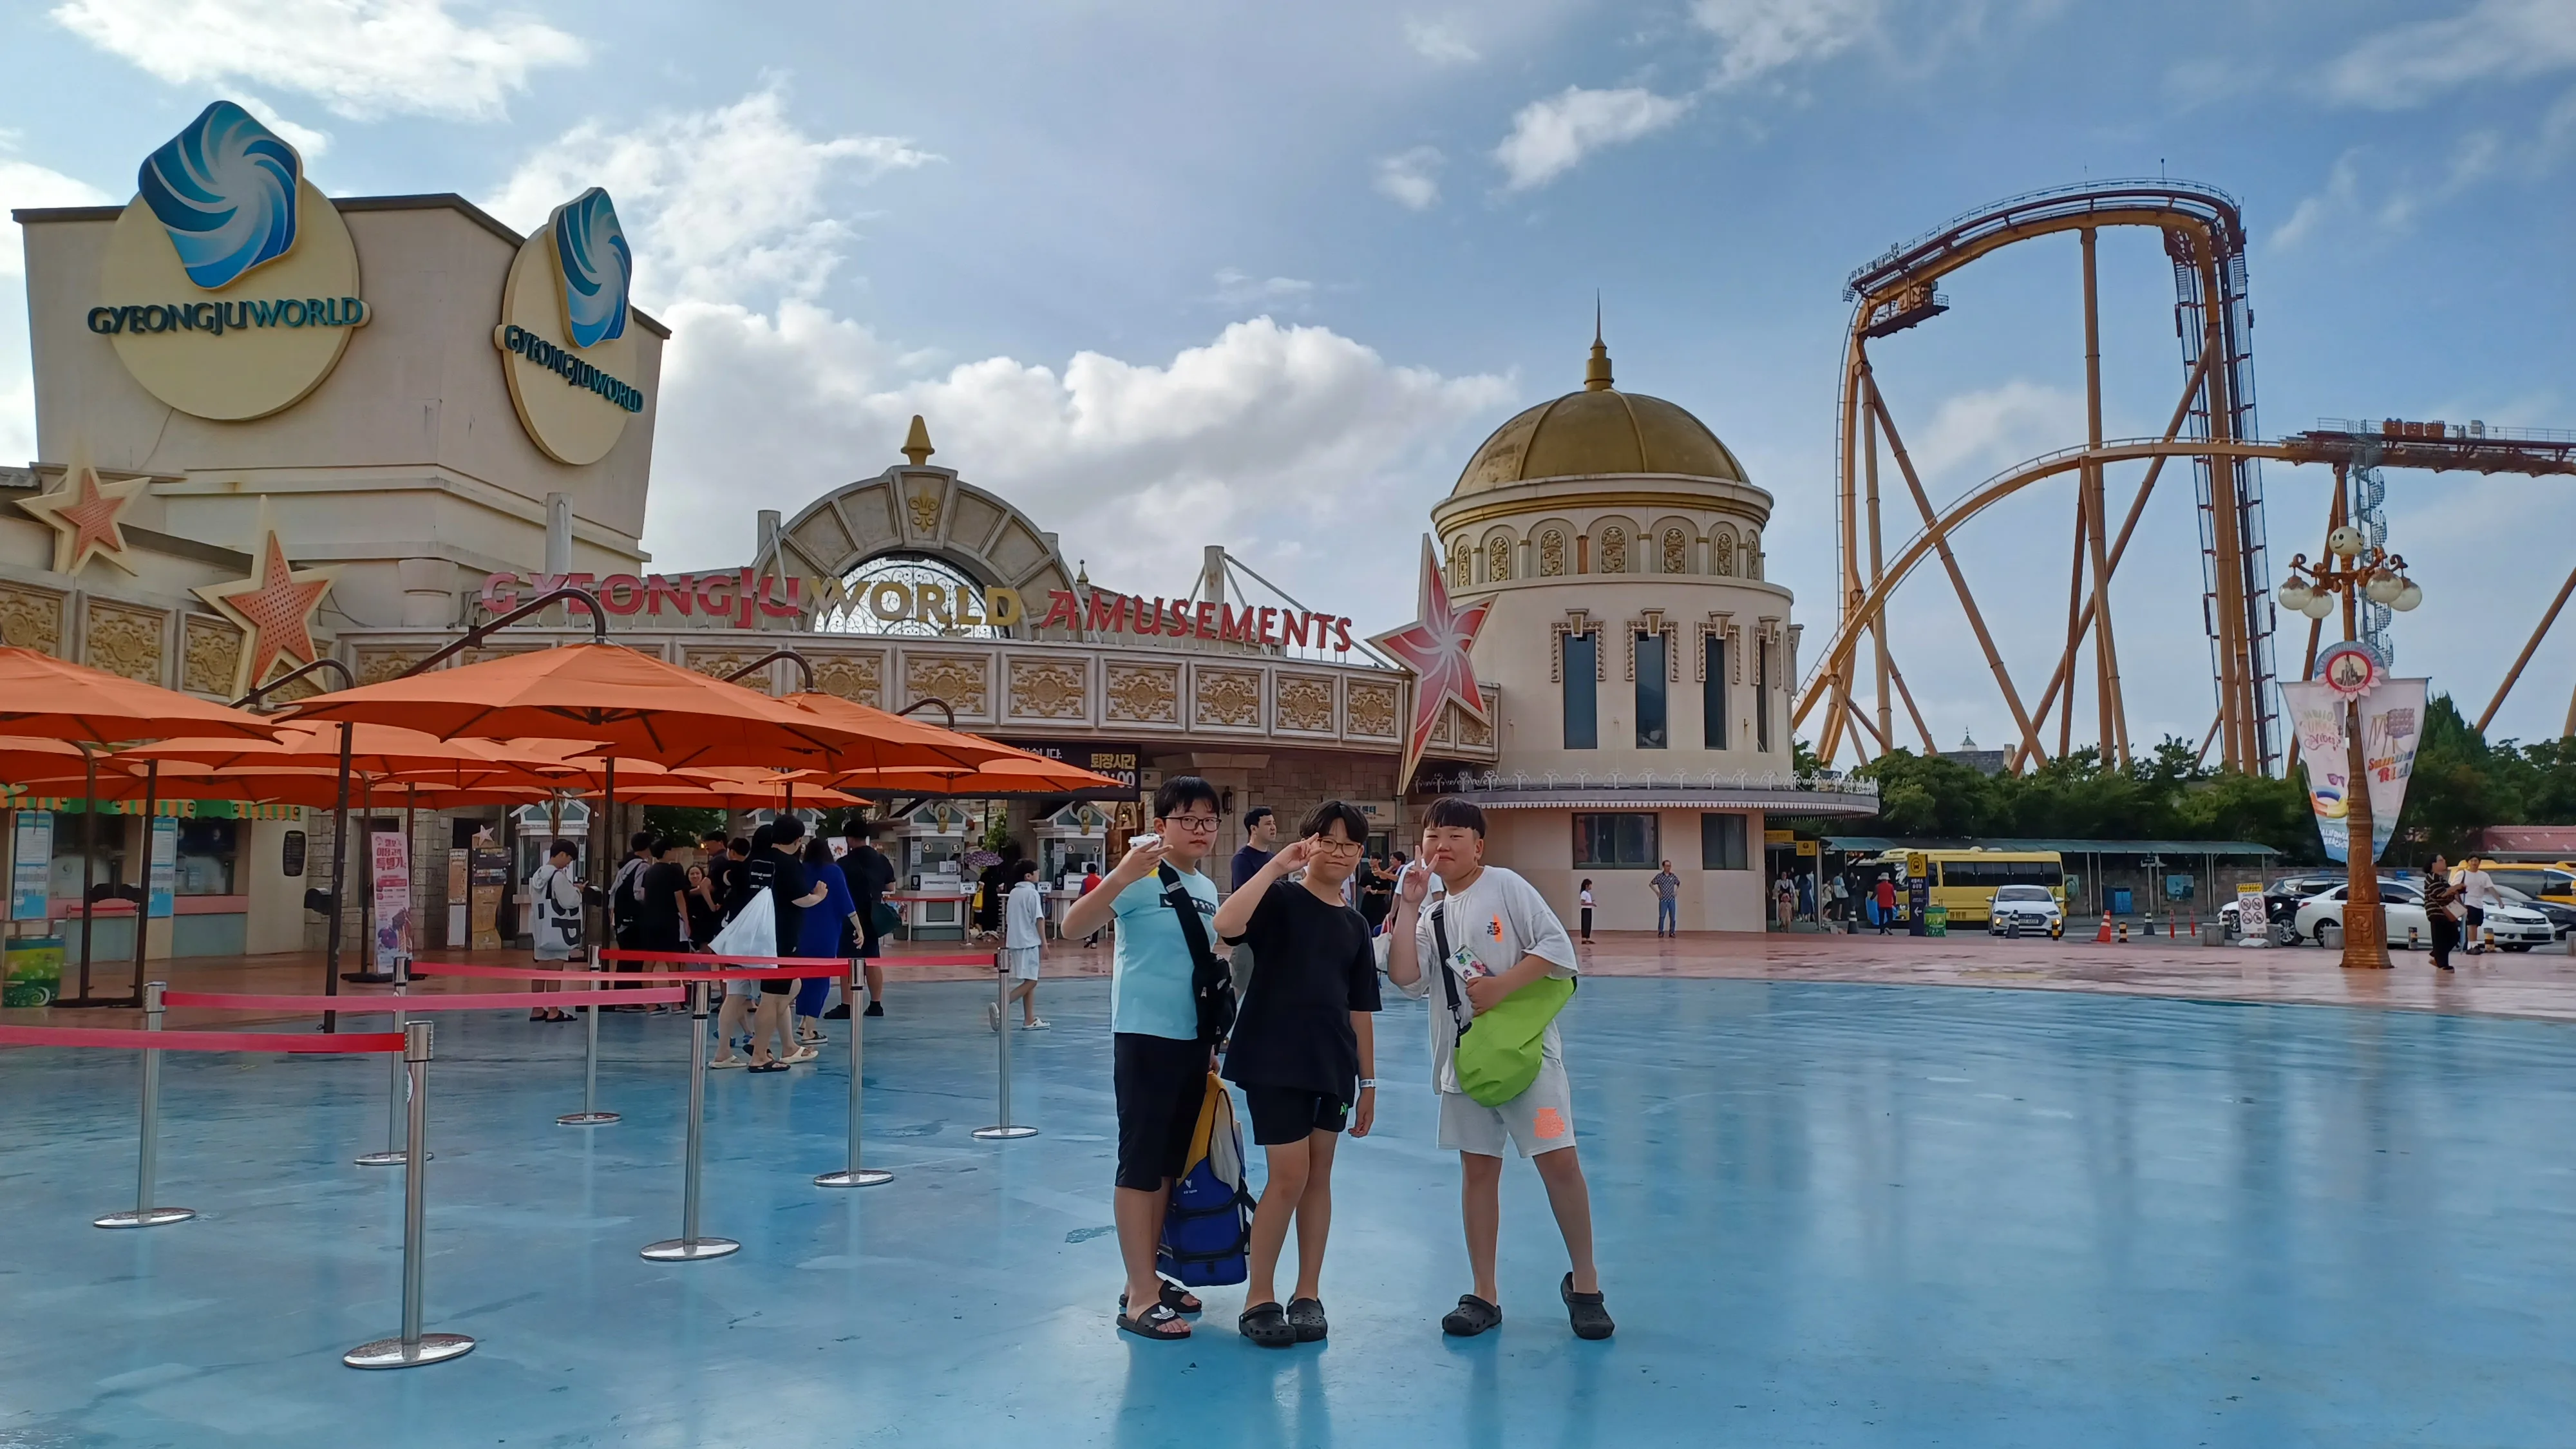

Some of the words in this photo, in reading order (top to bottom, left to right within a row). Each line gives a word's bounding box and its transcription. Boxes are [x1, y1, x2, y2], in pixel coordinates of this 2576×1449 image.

[482, 567, 800, 629] GYEONGJU
[806, 577, 1021, 626] WORLD
[1041, 589, 1352, 652] AMUSEMENTS
[1090, 753, 1136, 769] 퇴장시간
